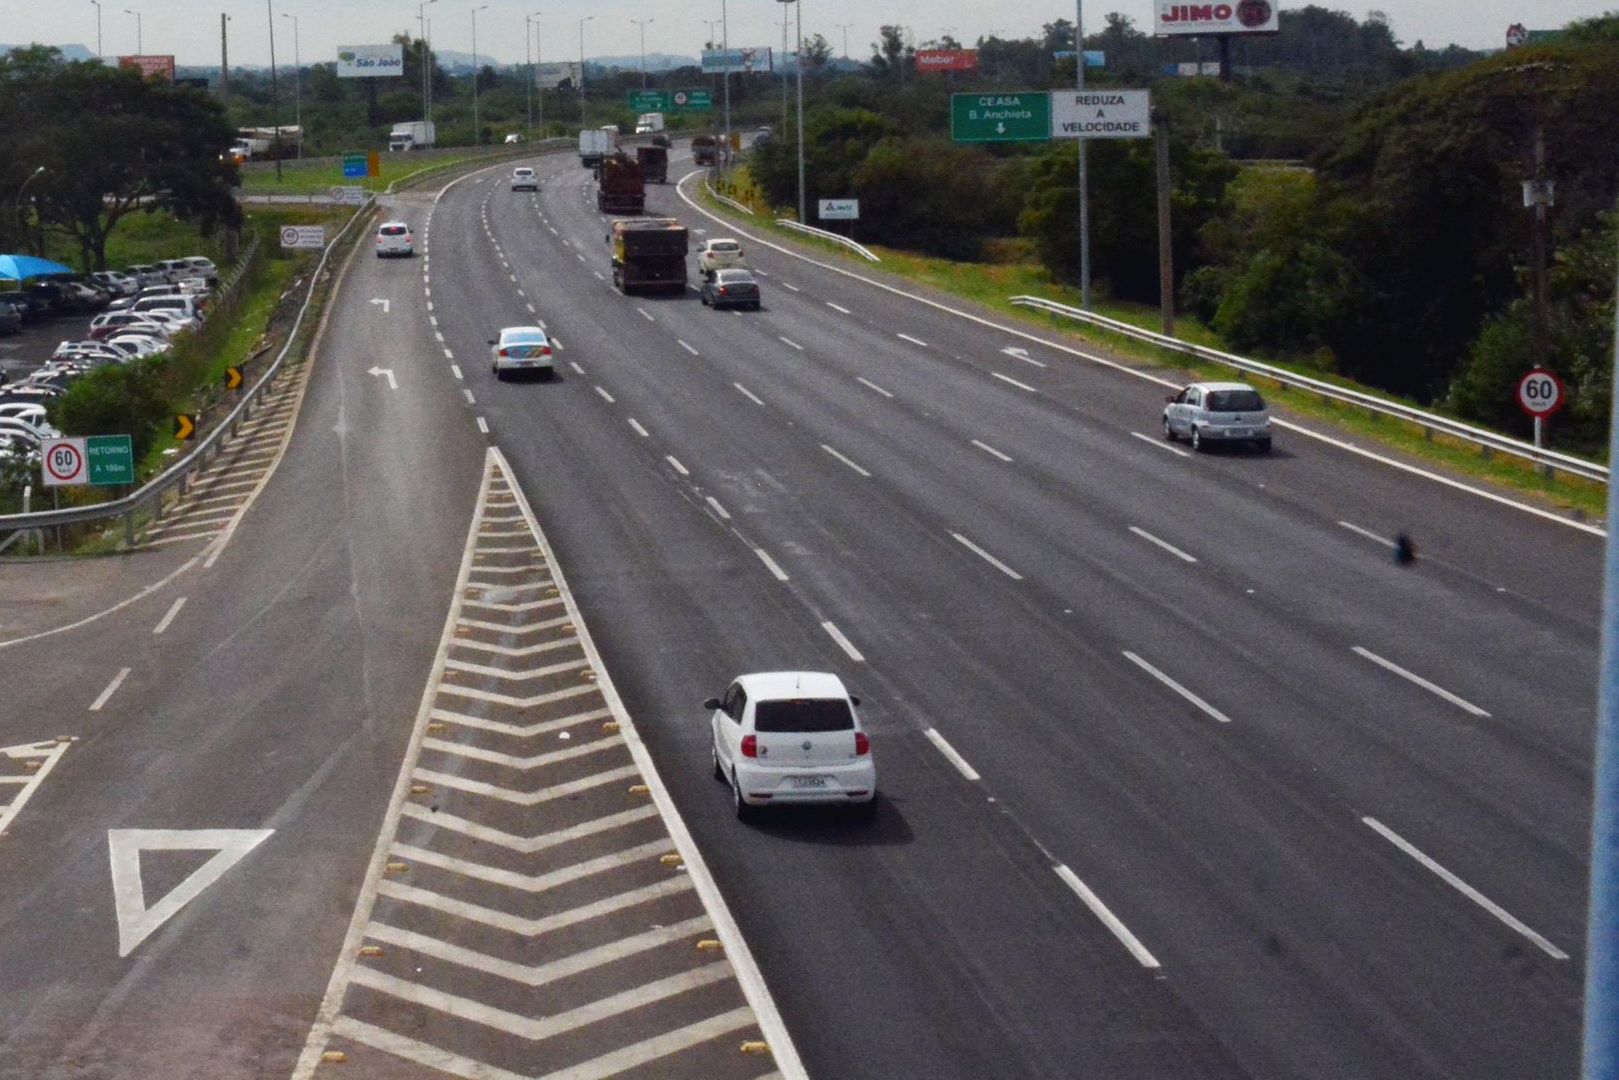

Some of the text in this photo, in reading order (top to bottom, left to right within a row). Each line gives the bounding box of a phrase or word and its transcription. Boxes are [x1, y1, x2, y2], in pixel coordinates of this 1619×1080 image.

[1161, 4, 1232, 22] JIMO
[979, 96, 1021, 107] CEASA
[1075, 95, 1125, 106] REDUZA
[984, 109, 1032, 120] Anchieta
[1096, 109, 1105, 118] A
[1063, 122, 1140, 133] VELOCIDADE
[1526, 379, 1553, 399] 60
[88, 445, 129, 456] RETORNO
[55, 451, 72, 466] 60
